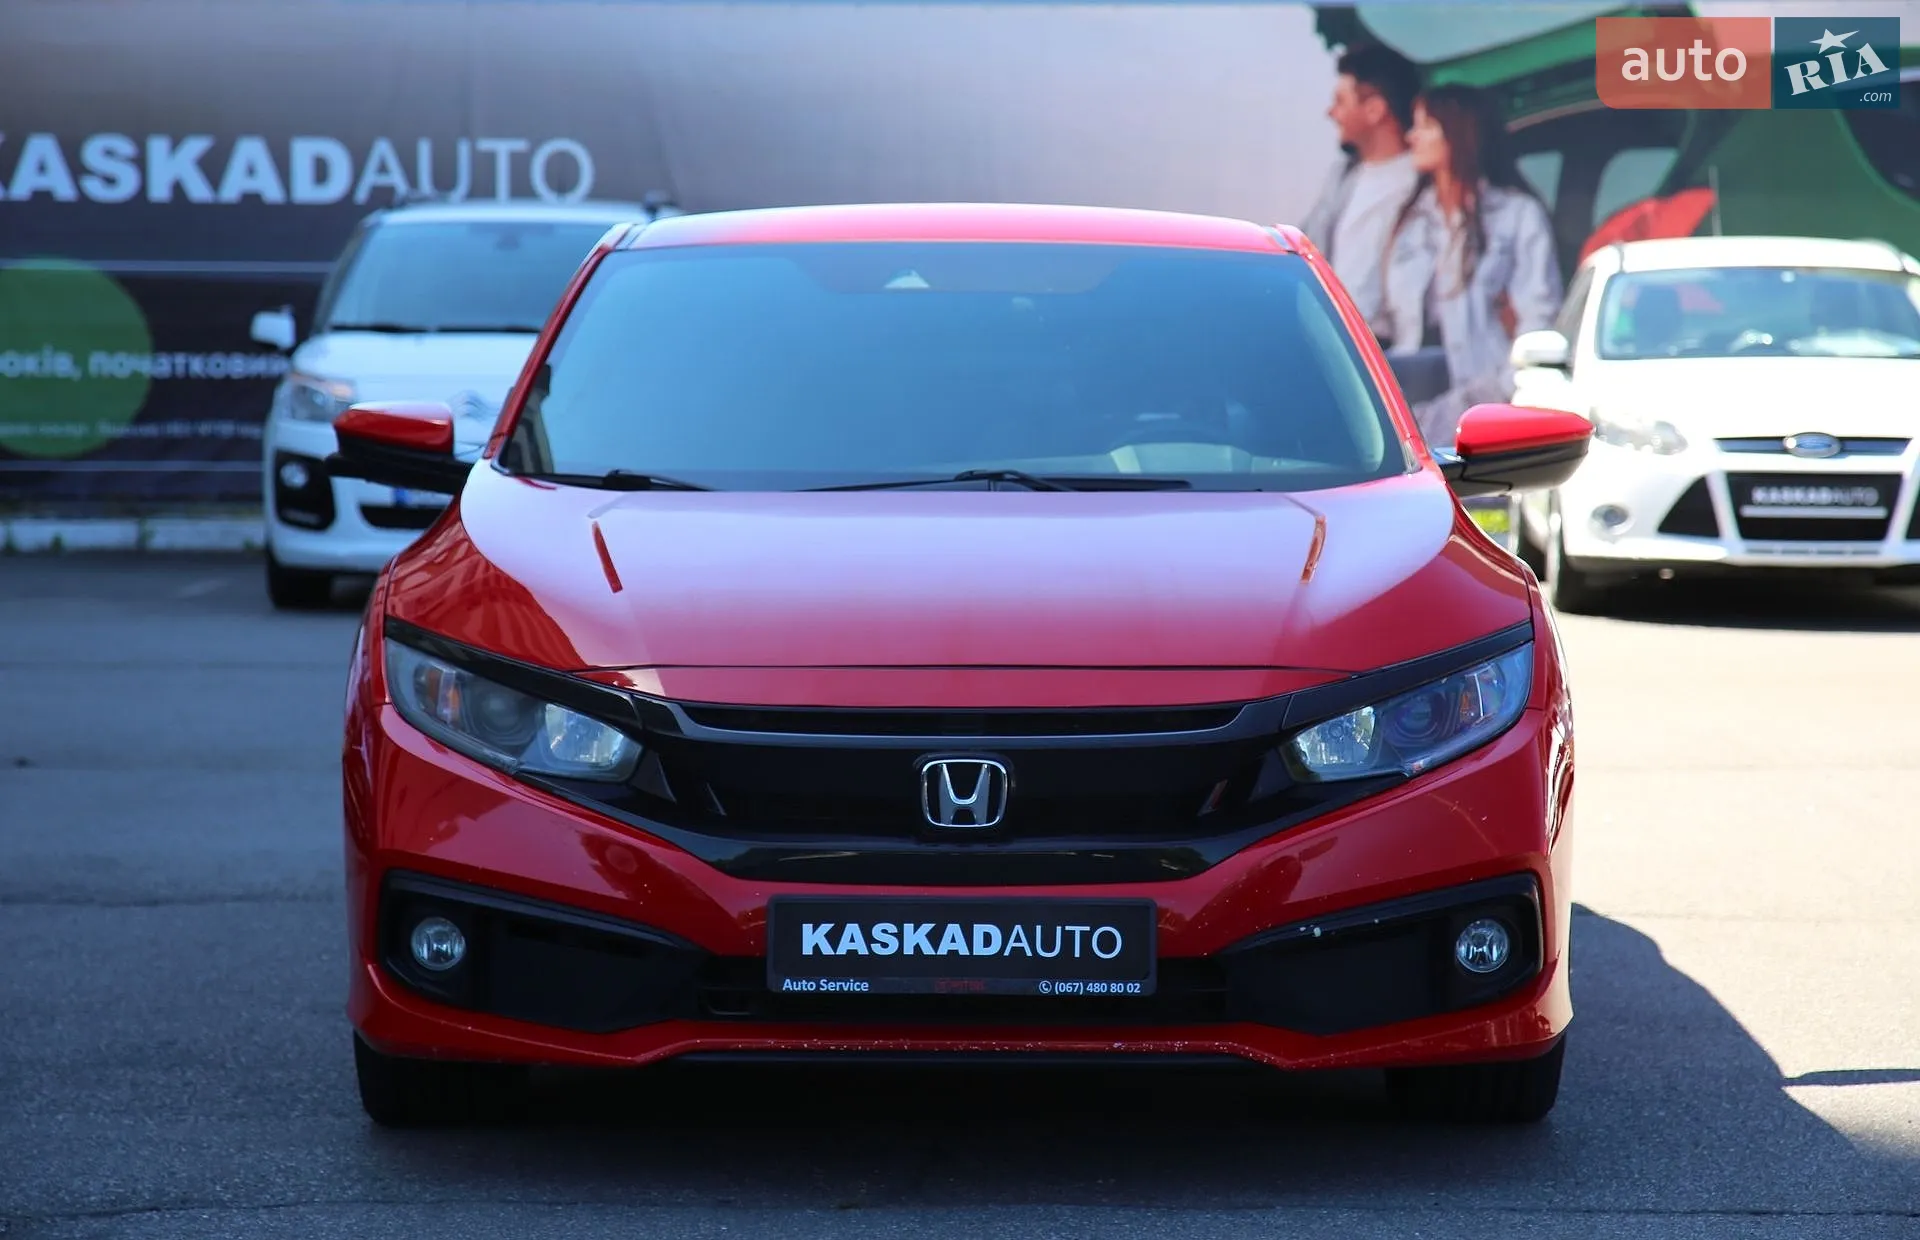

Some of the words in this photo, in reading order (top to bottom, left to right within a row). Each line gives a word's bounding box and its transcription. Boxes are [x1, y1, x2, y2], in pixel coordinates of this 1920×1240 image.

[0, 131, 596, 203] ASKADAUTO
[0, 345, 82, 381] оків,
[801, 922, 1123, 960] KASKADAUTO
[782, 978, 816, 991] Auto
[819, 978, 869, 992] Service
[1054, 981, 1084, 995] (067)
[1086, 982, 1108, 993] 480
[1110, 982, 1124, 993] 80
[1126, 982, 1141, 993] 02
